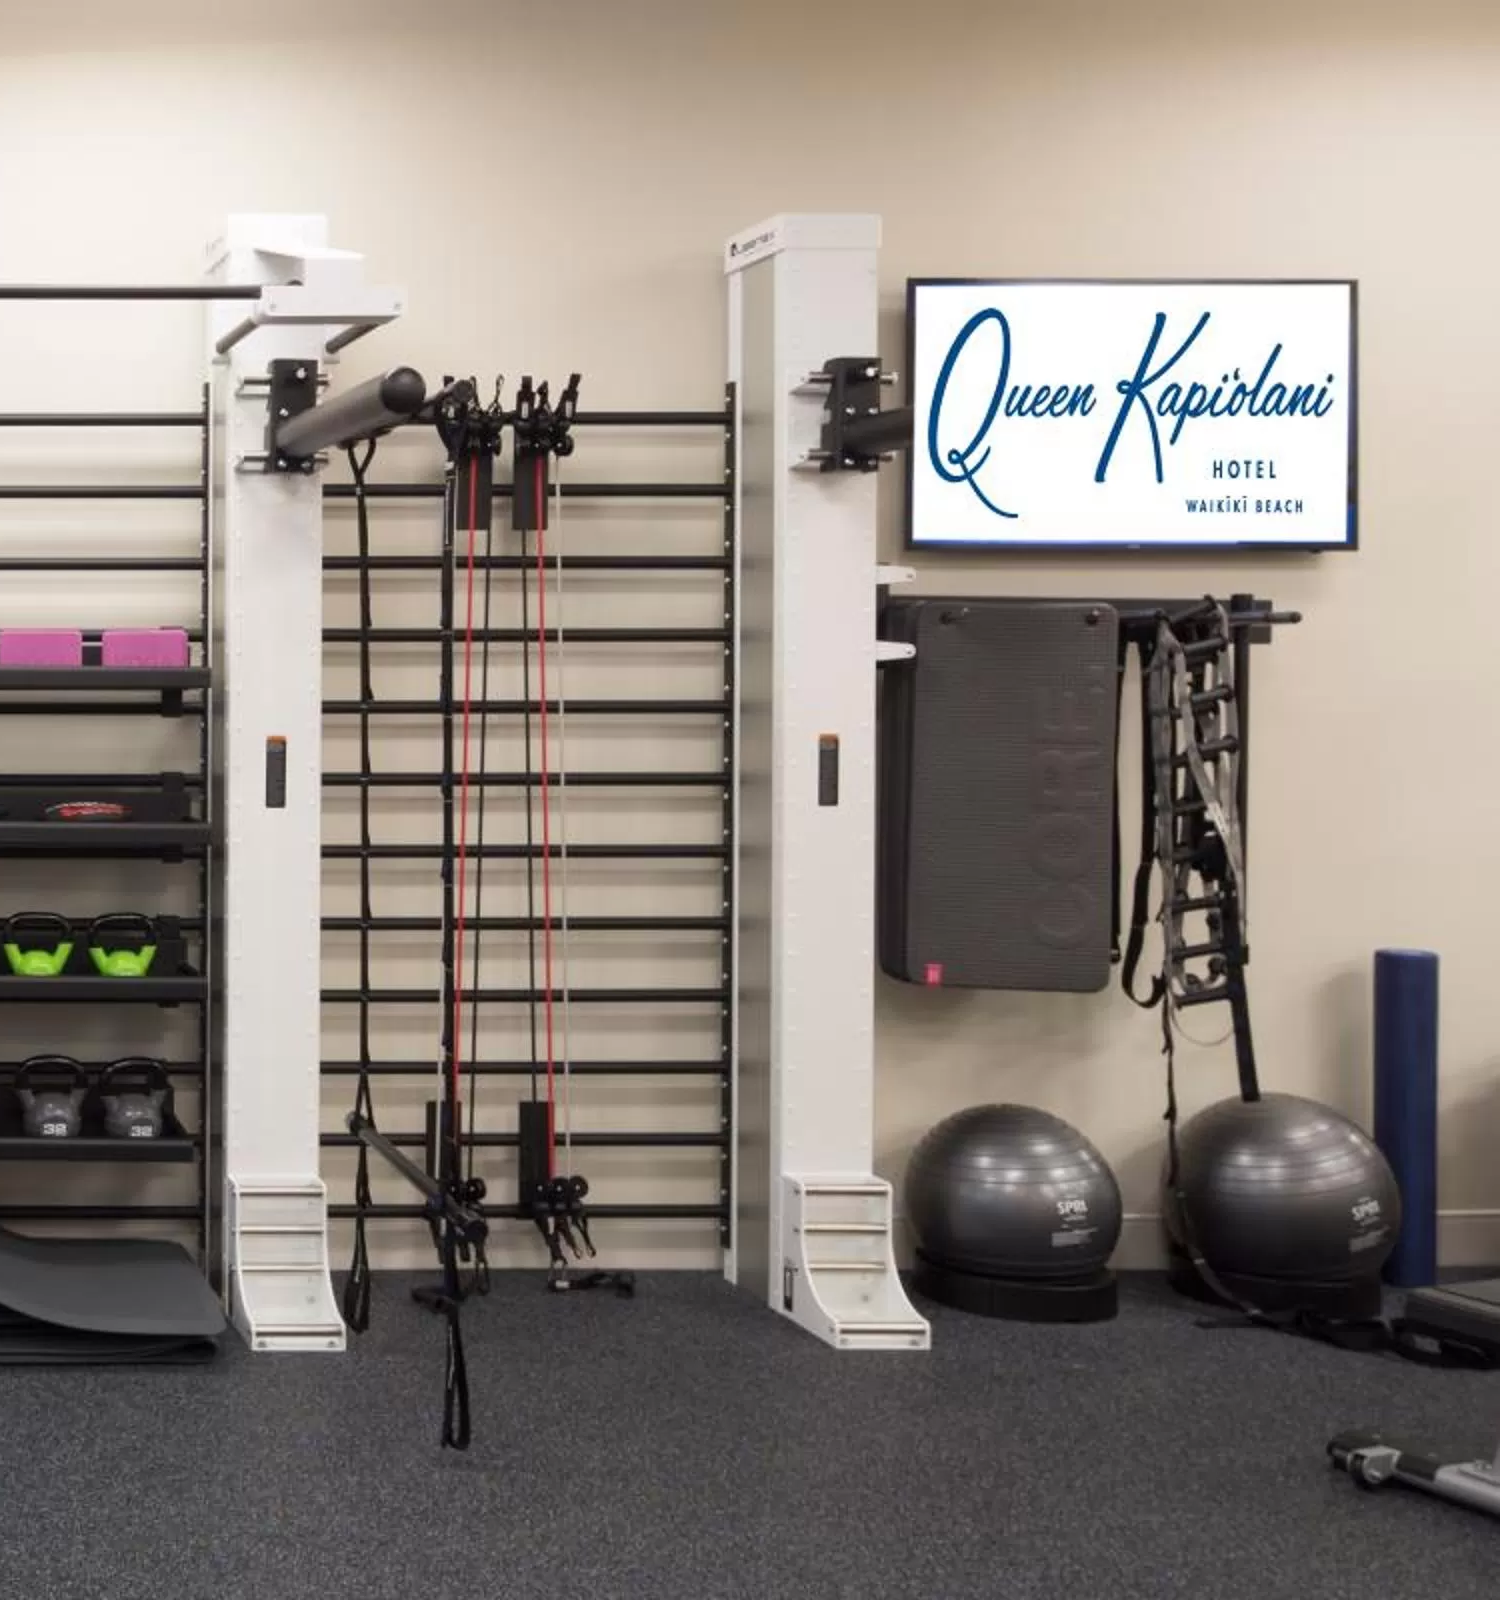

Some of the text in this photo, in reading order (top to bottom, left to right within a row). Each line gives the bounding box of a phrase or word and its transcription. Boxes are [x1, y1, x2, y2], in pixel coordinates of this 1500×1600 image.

[927, 307, 1097, 519] Queen
[1212, 460, 1277, 479] HOTEL
[1255, 499, 1303, 513] BEACH
